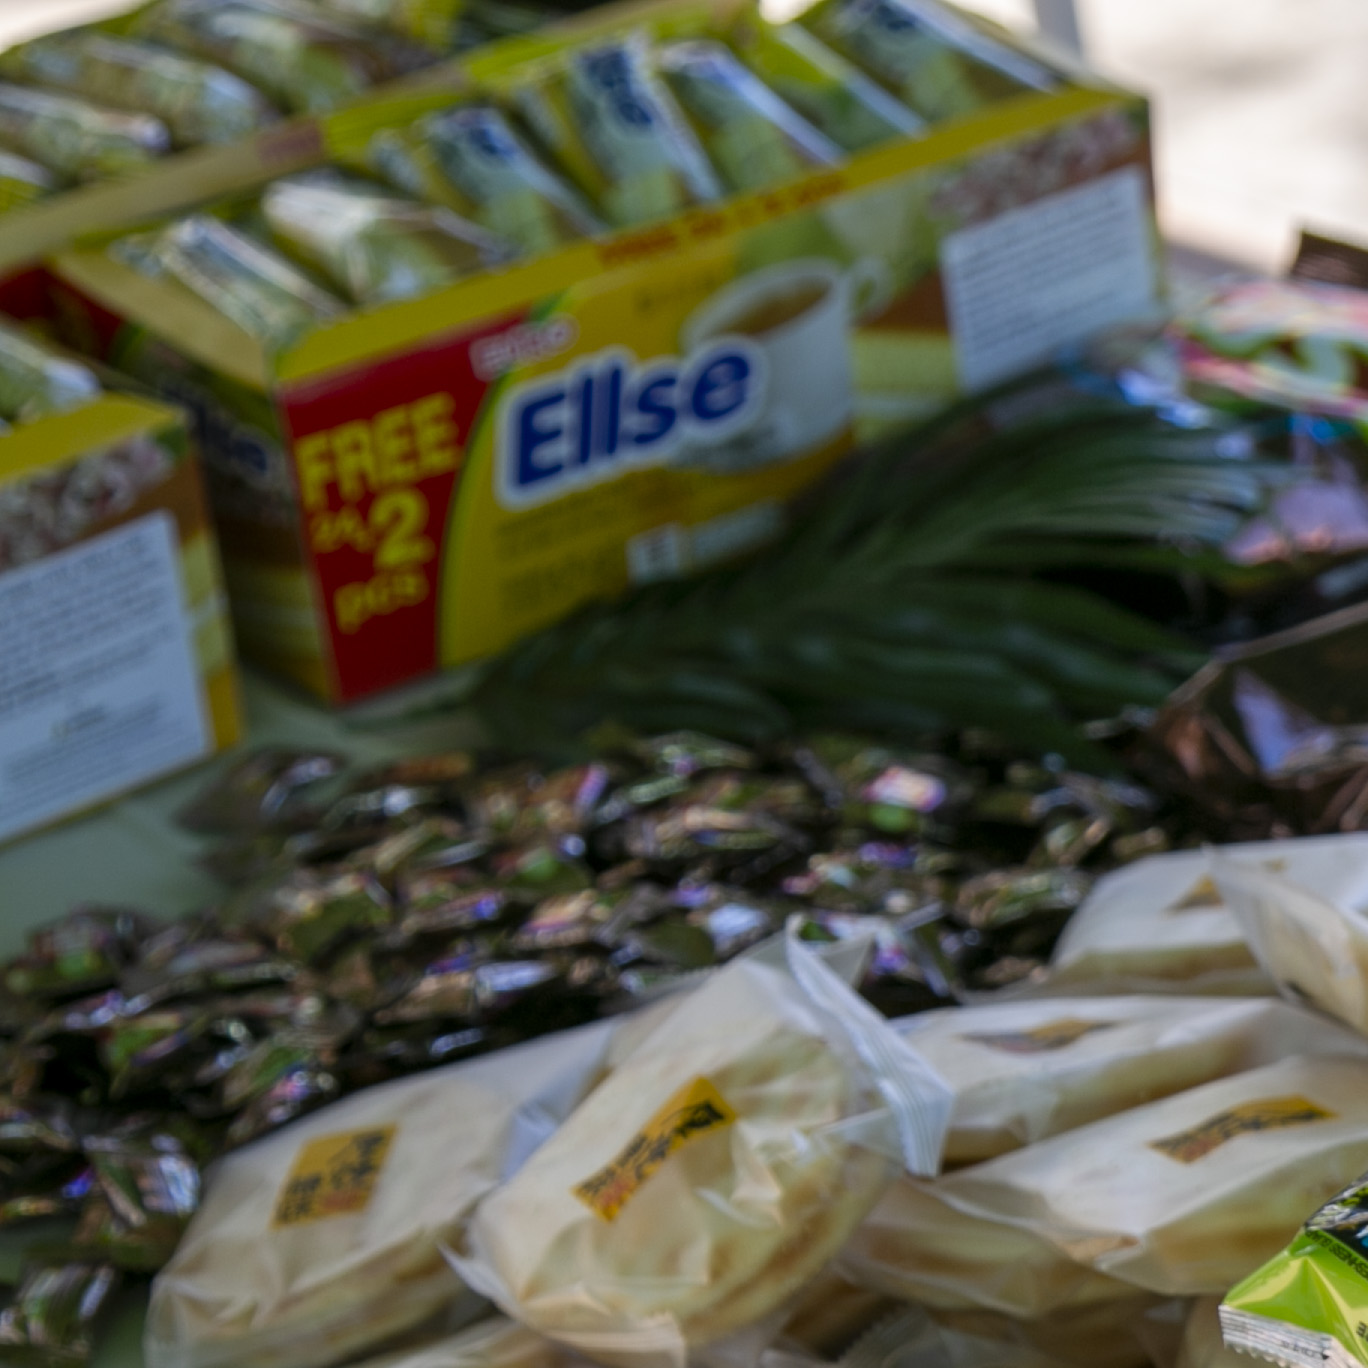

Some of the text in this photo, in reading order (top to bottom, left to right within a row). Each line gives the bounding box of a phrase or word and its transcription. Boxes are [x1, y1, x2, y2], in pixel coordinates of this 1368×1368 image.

[296, 392, 457, 508] FREE
[517, 353, 753, 488] Ellse
[368, 487, 434, 569] 2
